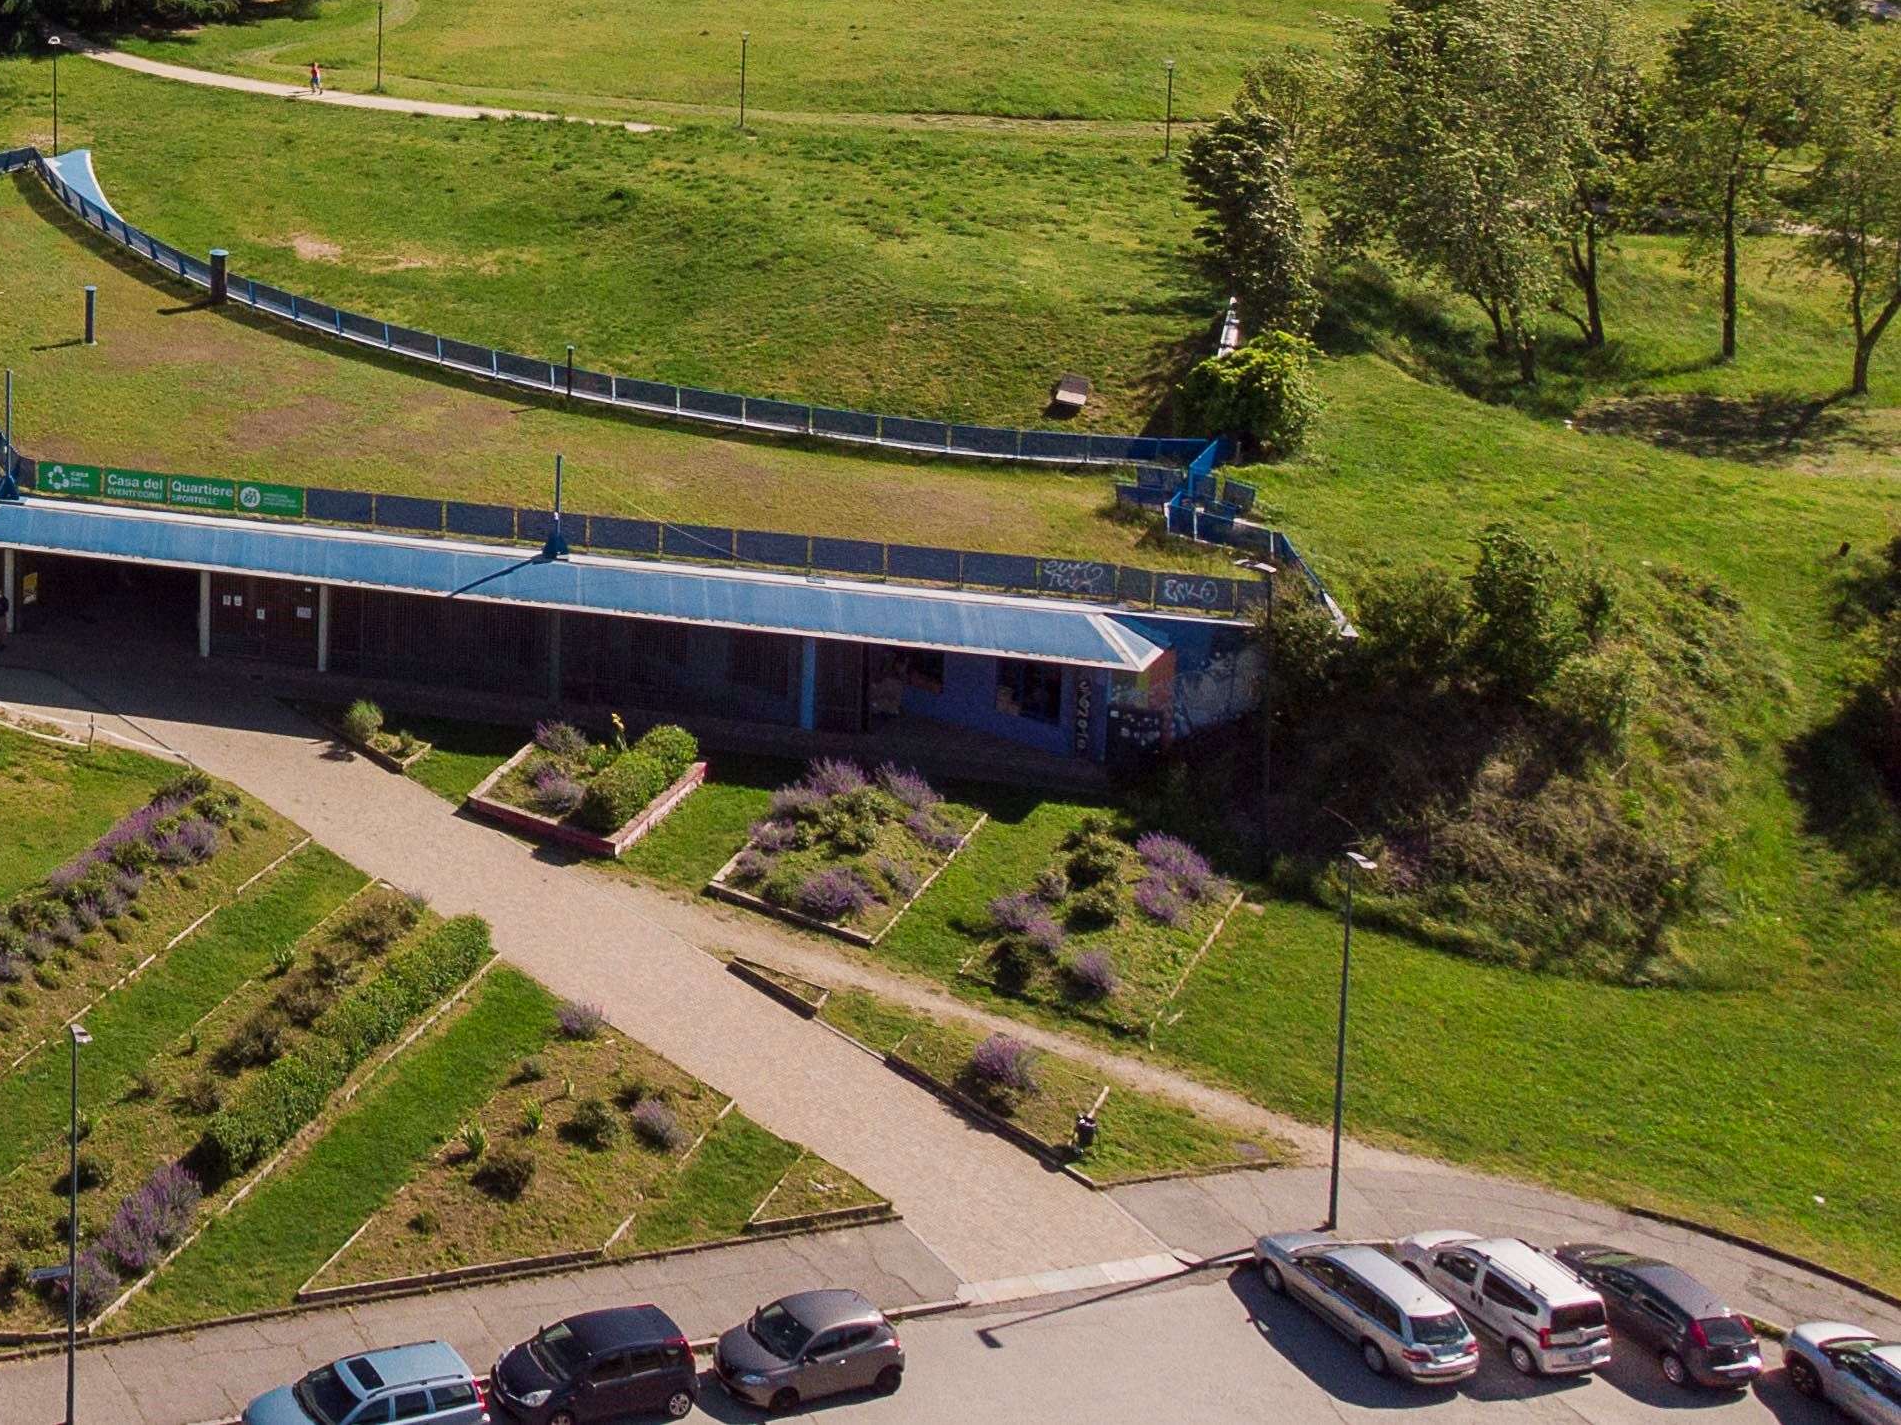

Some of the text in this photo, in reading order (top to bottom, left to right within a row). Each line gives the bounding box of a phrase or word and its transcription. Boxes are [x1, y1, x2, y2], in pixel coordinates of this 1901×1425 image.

[107, 474, 233, 497] Casa del Quartiere
